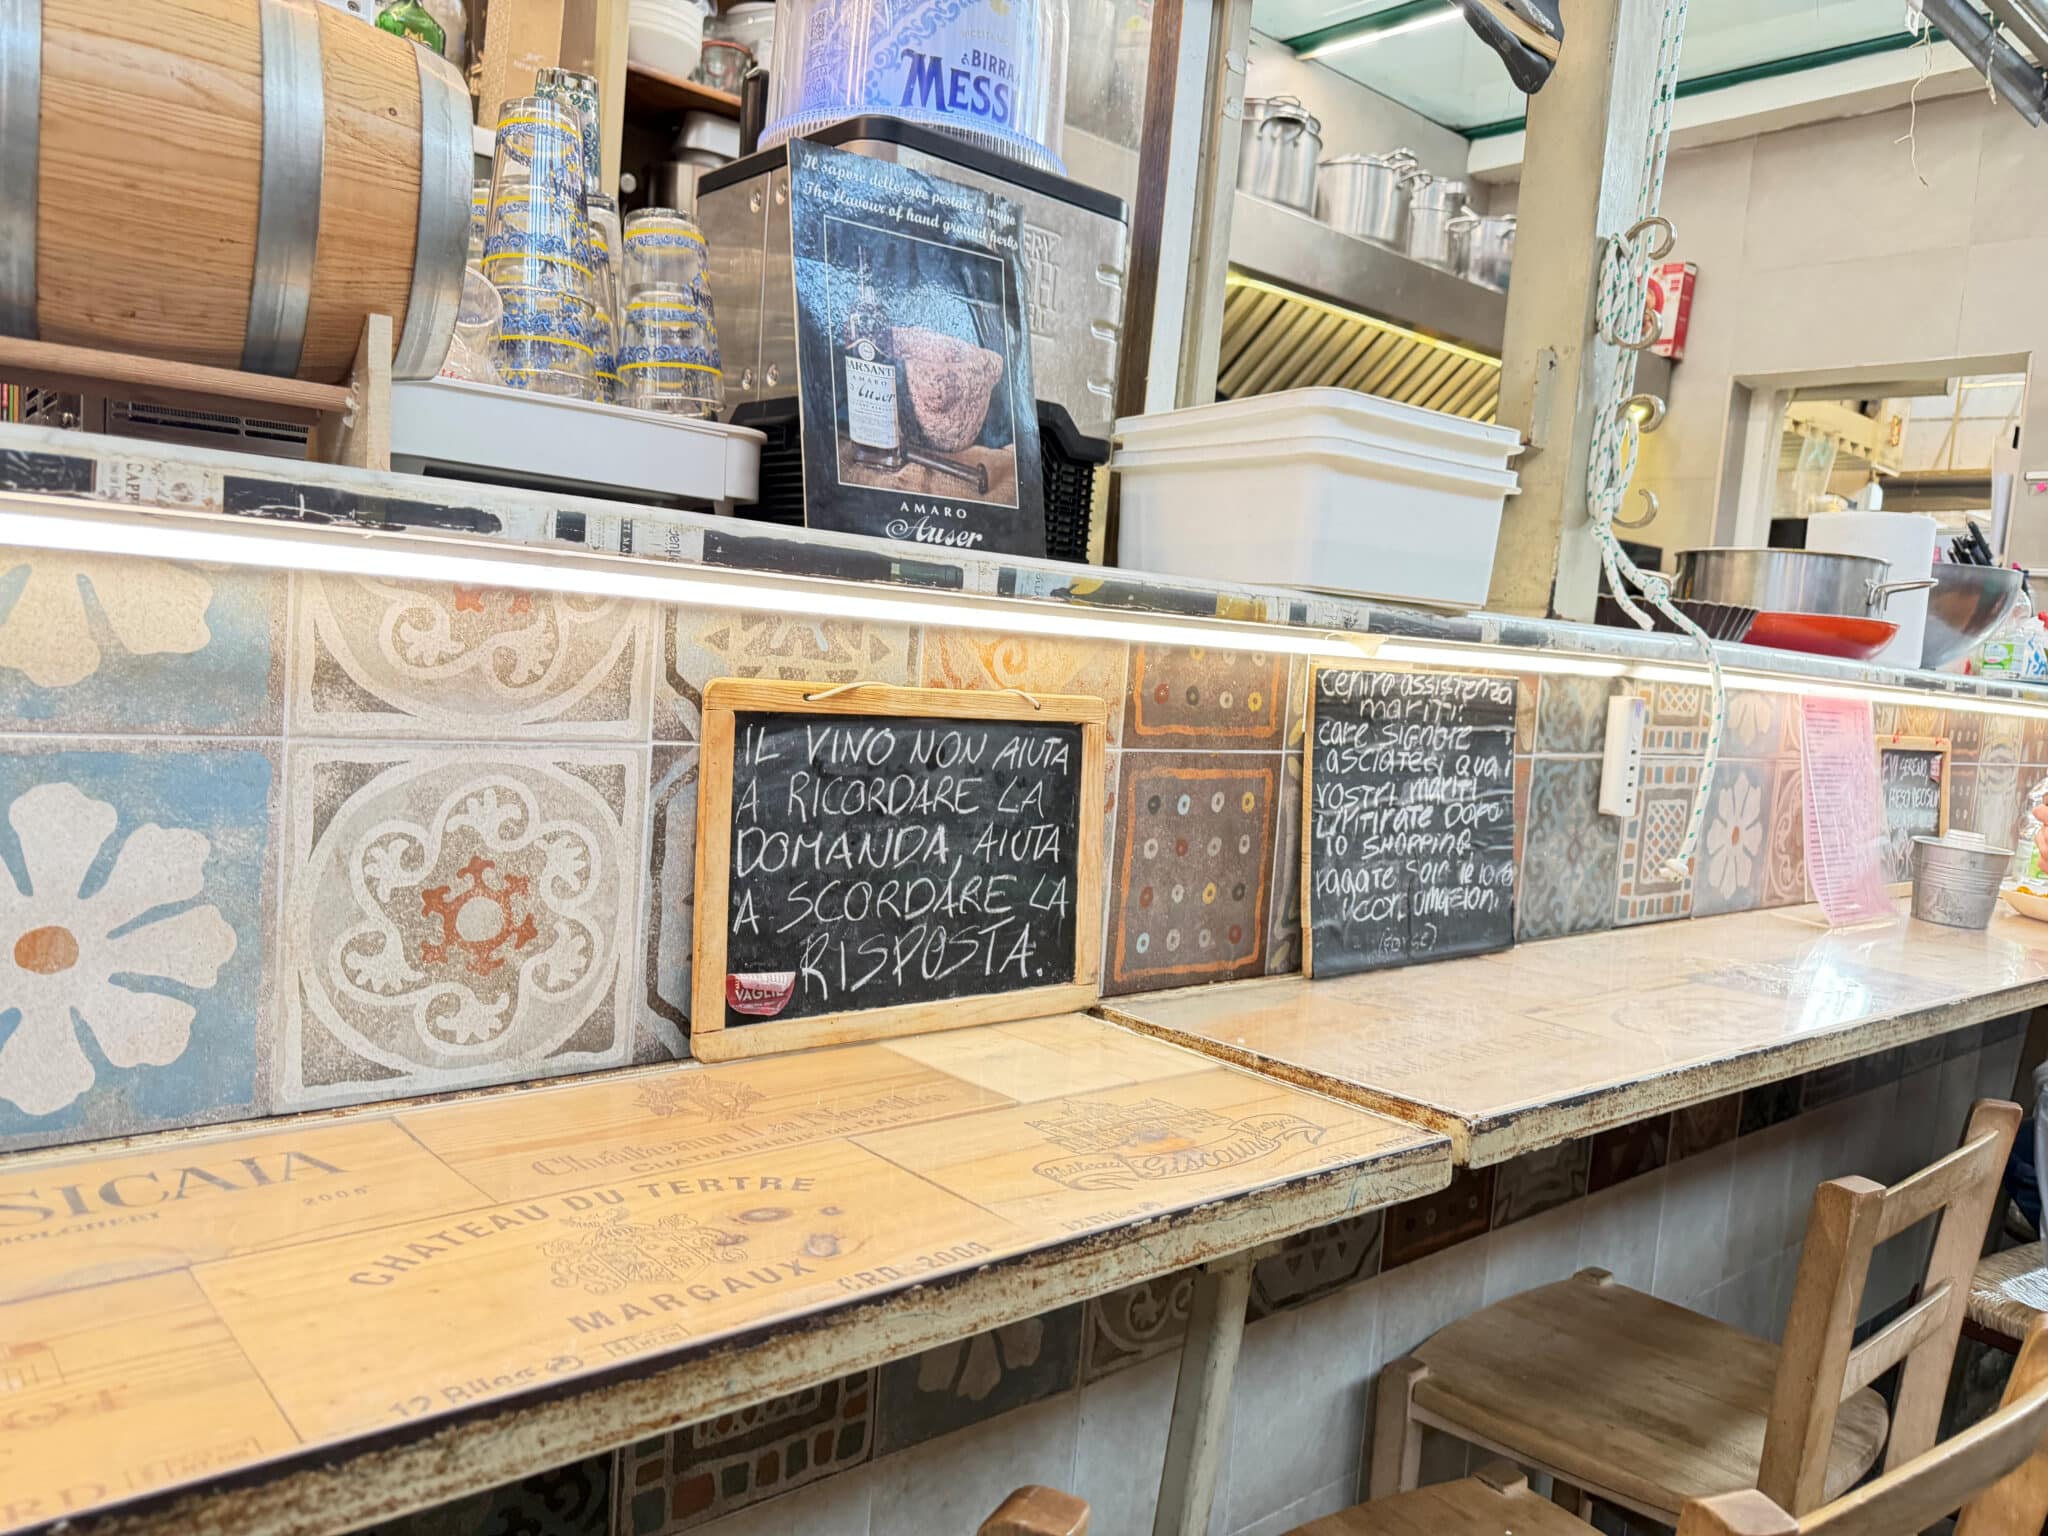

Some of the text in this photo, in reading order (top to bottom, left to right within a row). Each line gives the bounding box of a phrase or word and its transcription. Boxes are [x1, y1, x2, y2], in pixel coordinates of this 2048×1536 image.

[802, 181, 1020, 251] The flavour of hand ground herbs
[820, 162, 866, 185] sapore
[869, 171, 901, 193] delle
[901, 182, 930, 202] erbe
[931, 190, 974, 213] pestate
[976, 203, 985, 216] a
[986, 207, 1018, 227] mano
[885, 515, 984, 549] Auser
[900, 501, 968, 519] AMARO
[743, 723, 1070, 776] IL VINO NON AIUTA
[735, 771, 1045, 825] A RICORDARE LA
[736, 822, 1062, 882] DOMANDA, AIUTA
[733, 873, 1070, 937] A SCORDARE LA
[799, 914, 1045, 1000] RISPOSTA.
[349, 1175, 817, 1288] CHATEAU DU TERTRE
[566, 1257, 818, 1335] MARGAUX
